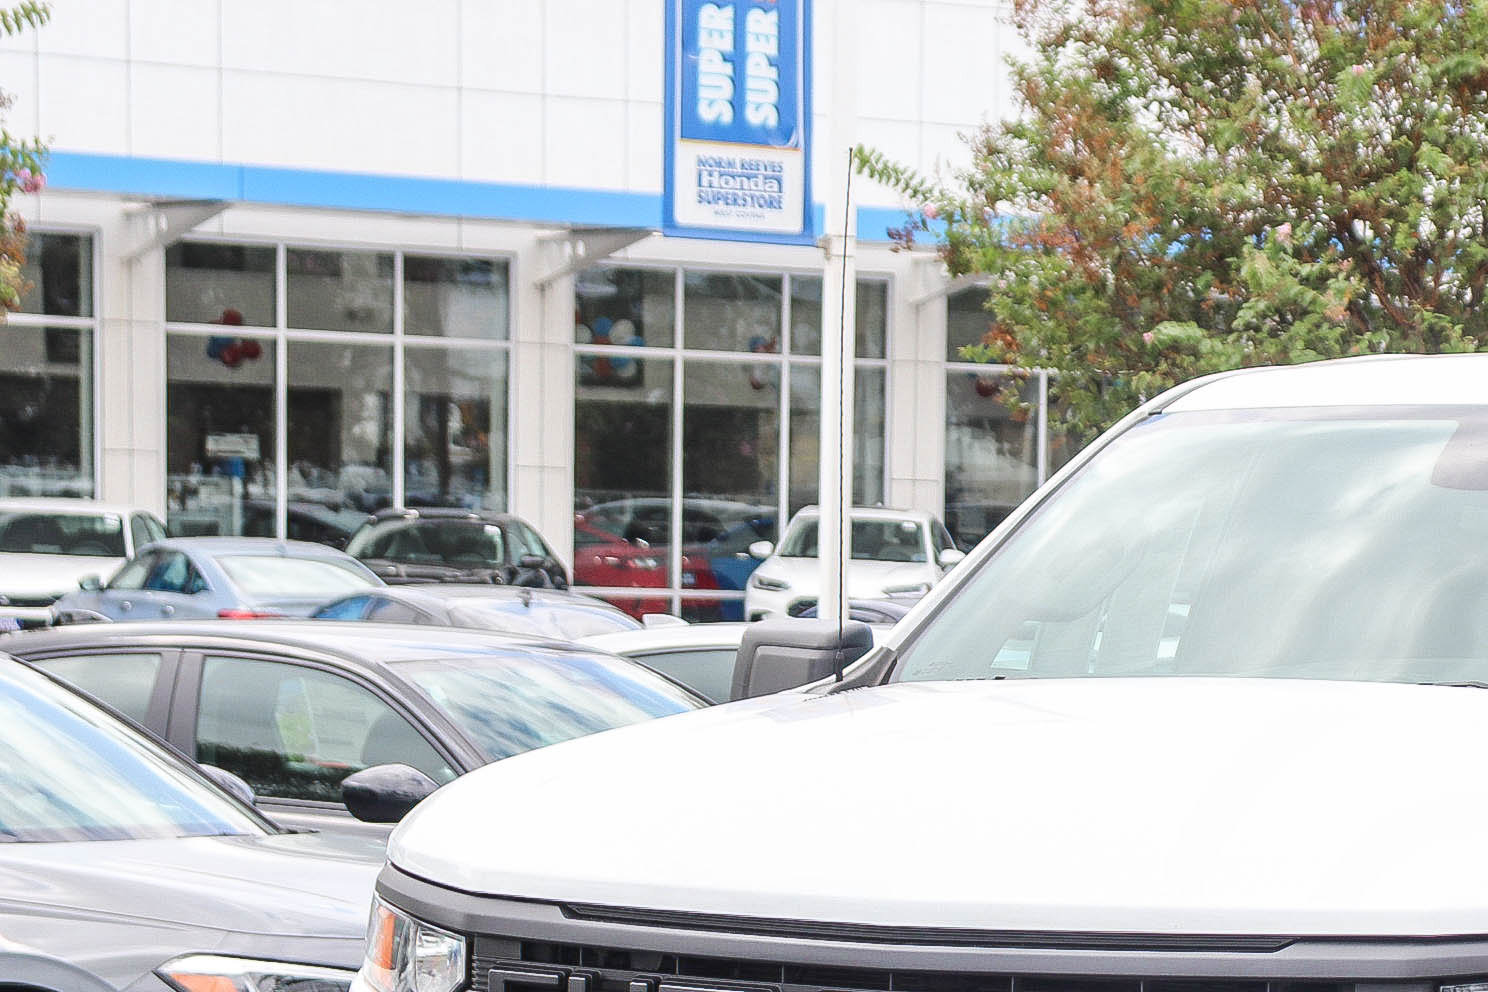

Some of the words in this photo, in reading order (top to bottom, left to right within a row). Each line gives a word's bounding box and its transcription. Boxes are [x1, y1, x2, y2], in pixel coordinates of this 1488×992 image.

[698, 2, 735, 125] SUPER
[744, 7, 780, 129] SUPER
[697, 188, 783, 210] SUPERSTORE
[701, 170, 780, 192] Honda
